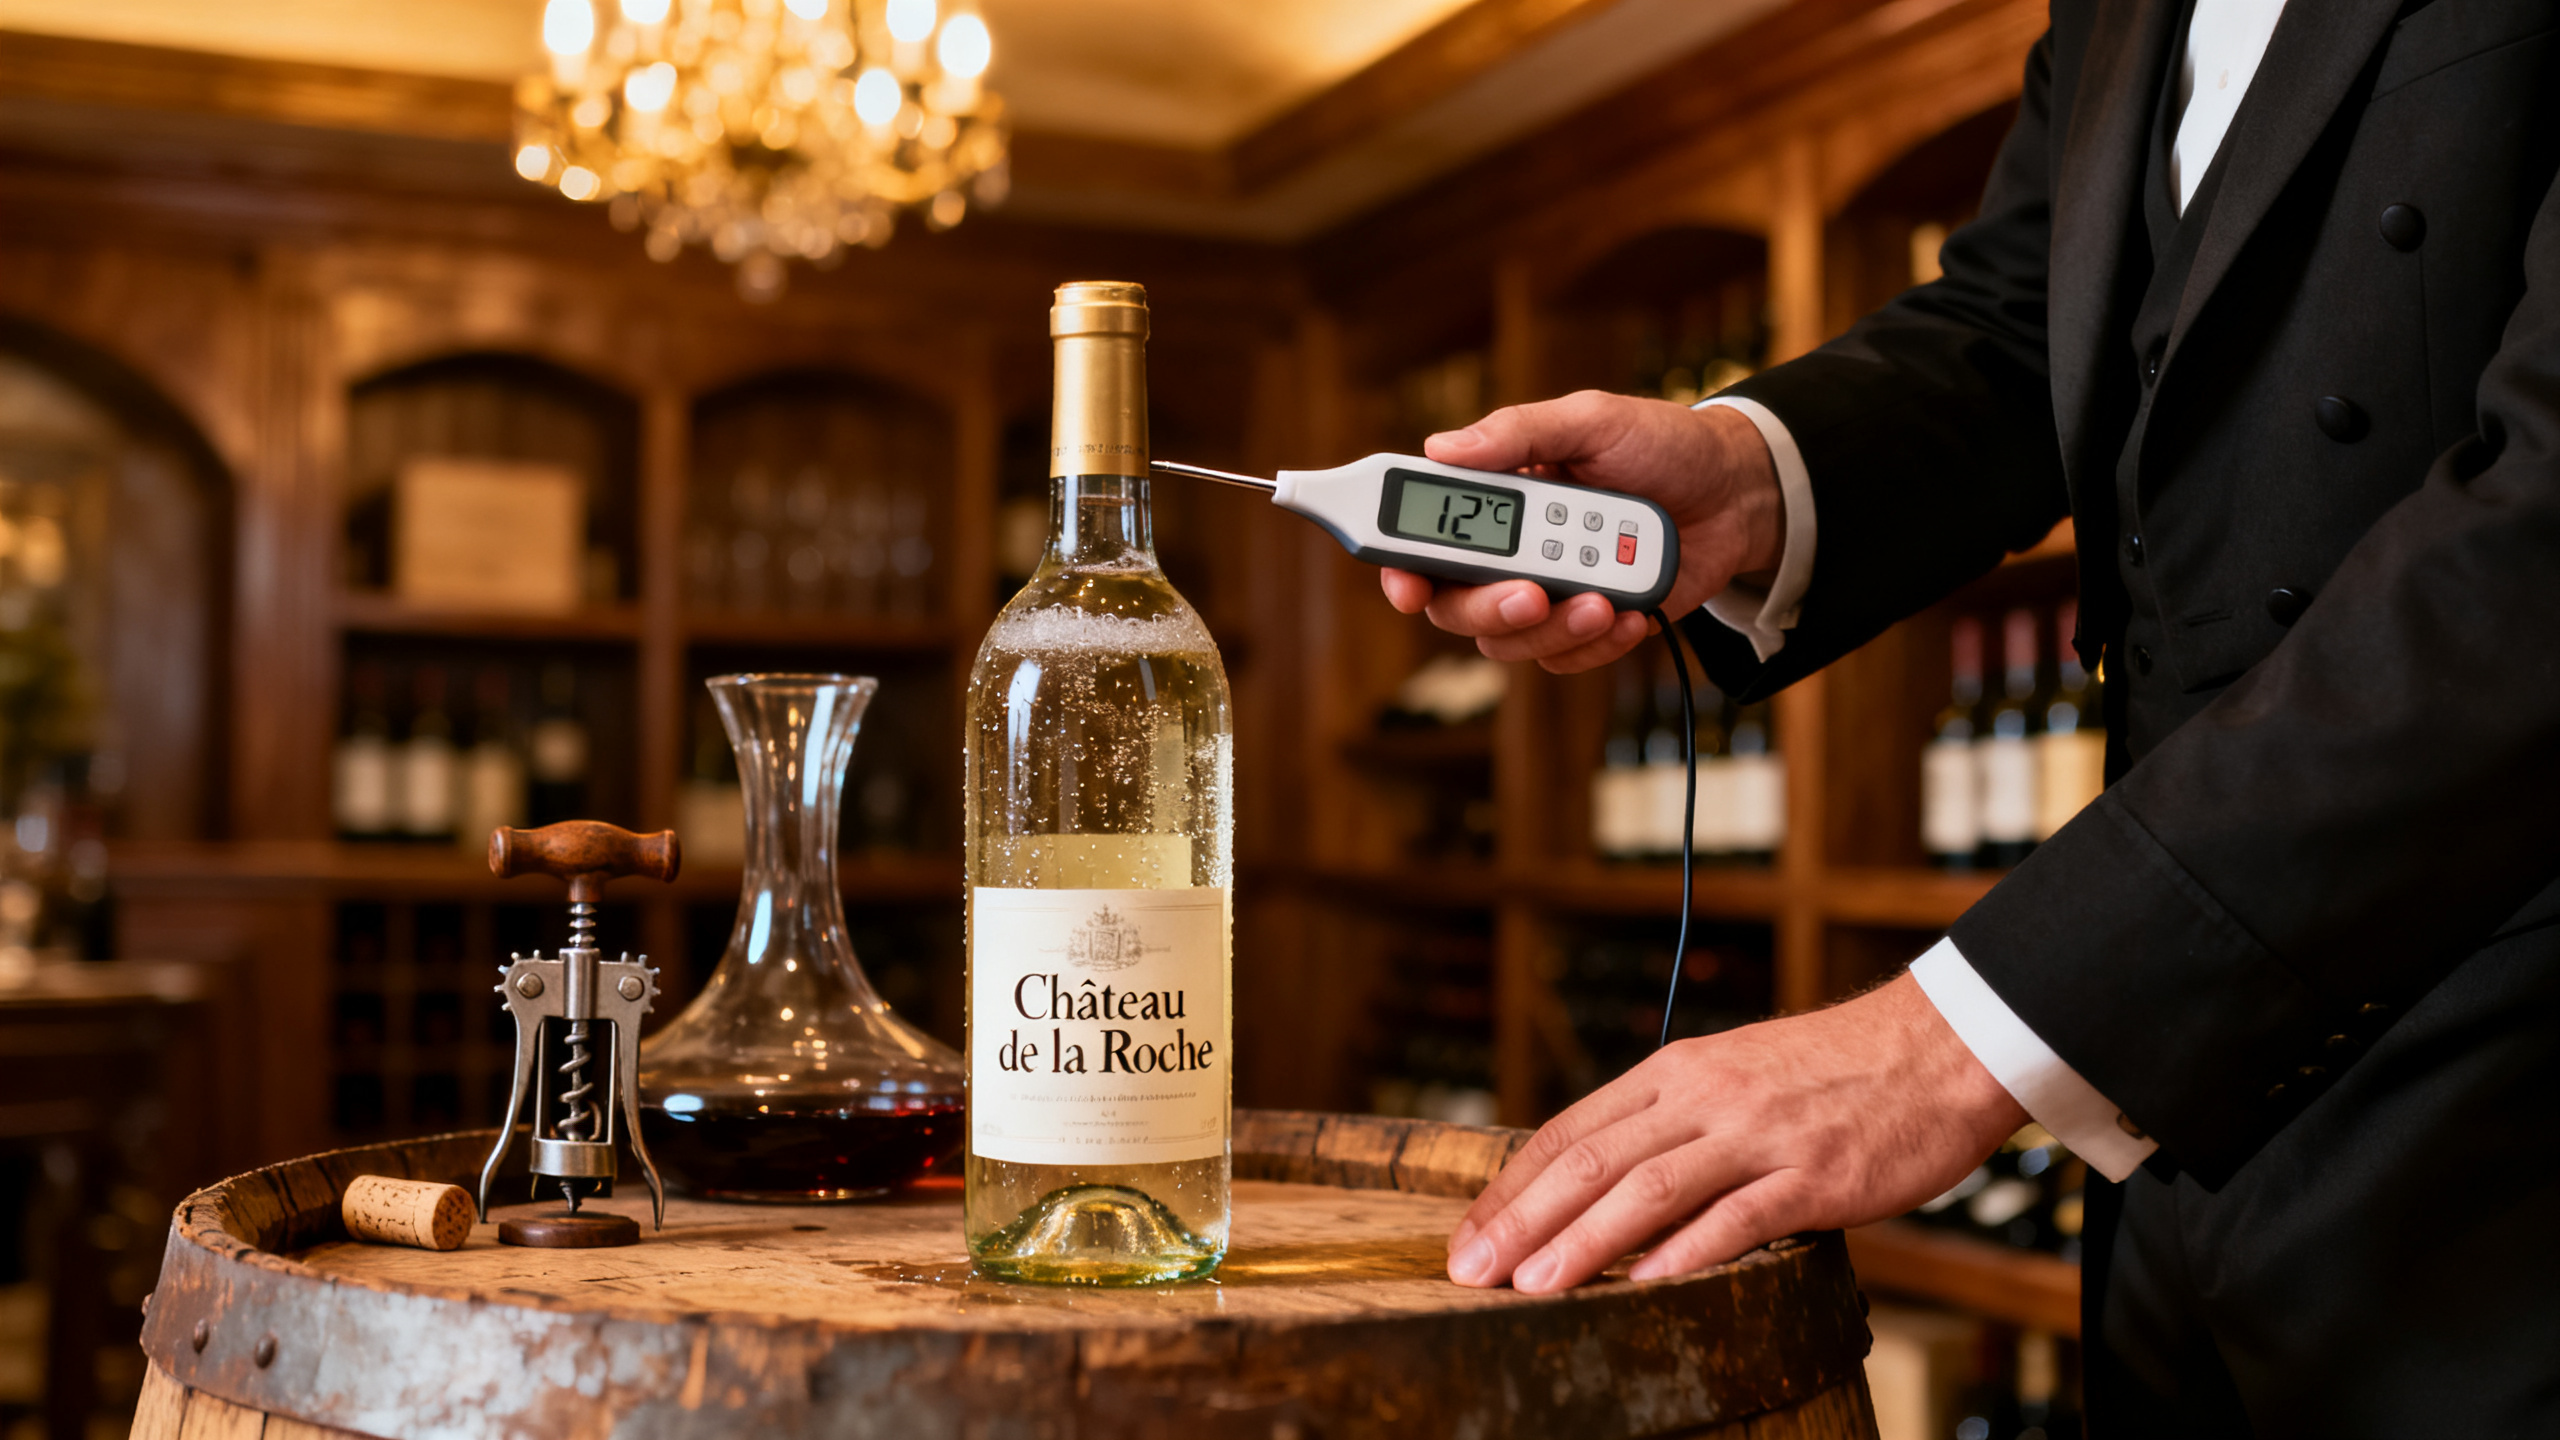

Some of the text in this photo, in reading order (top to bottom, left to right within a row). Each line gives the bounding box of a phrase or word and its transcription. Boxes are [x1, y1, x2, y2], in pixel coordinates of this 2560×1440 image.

[1014, 973, 1186, 1020] Château
[999, 1028, 1213, 1074] de la Roche
